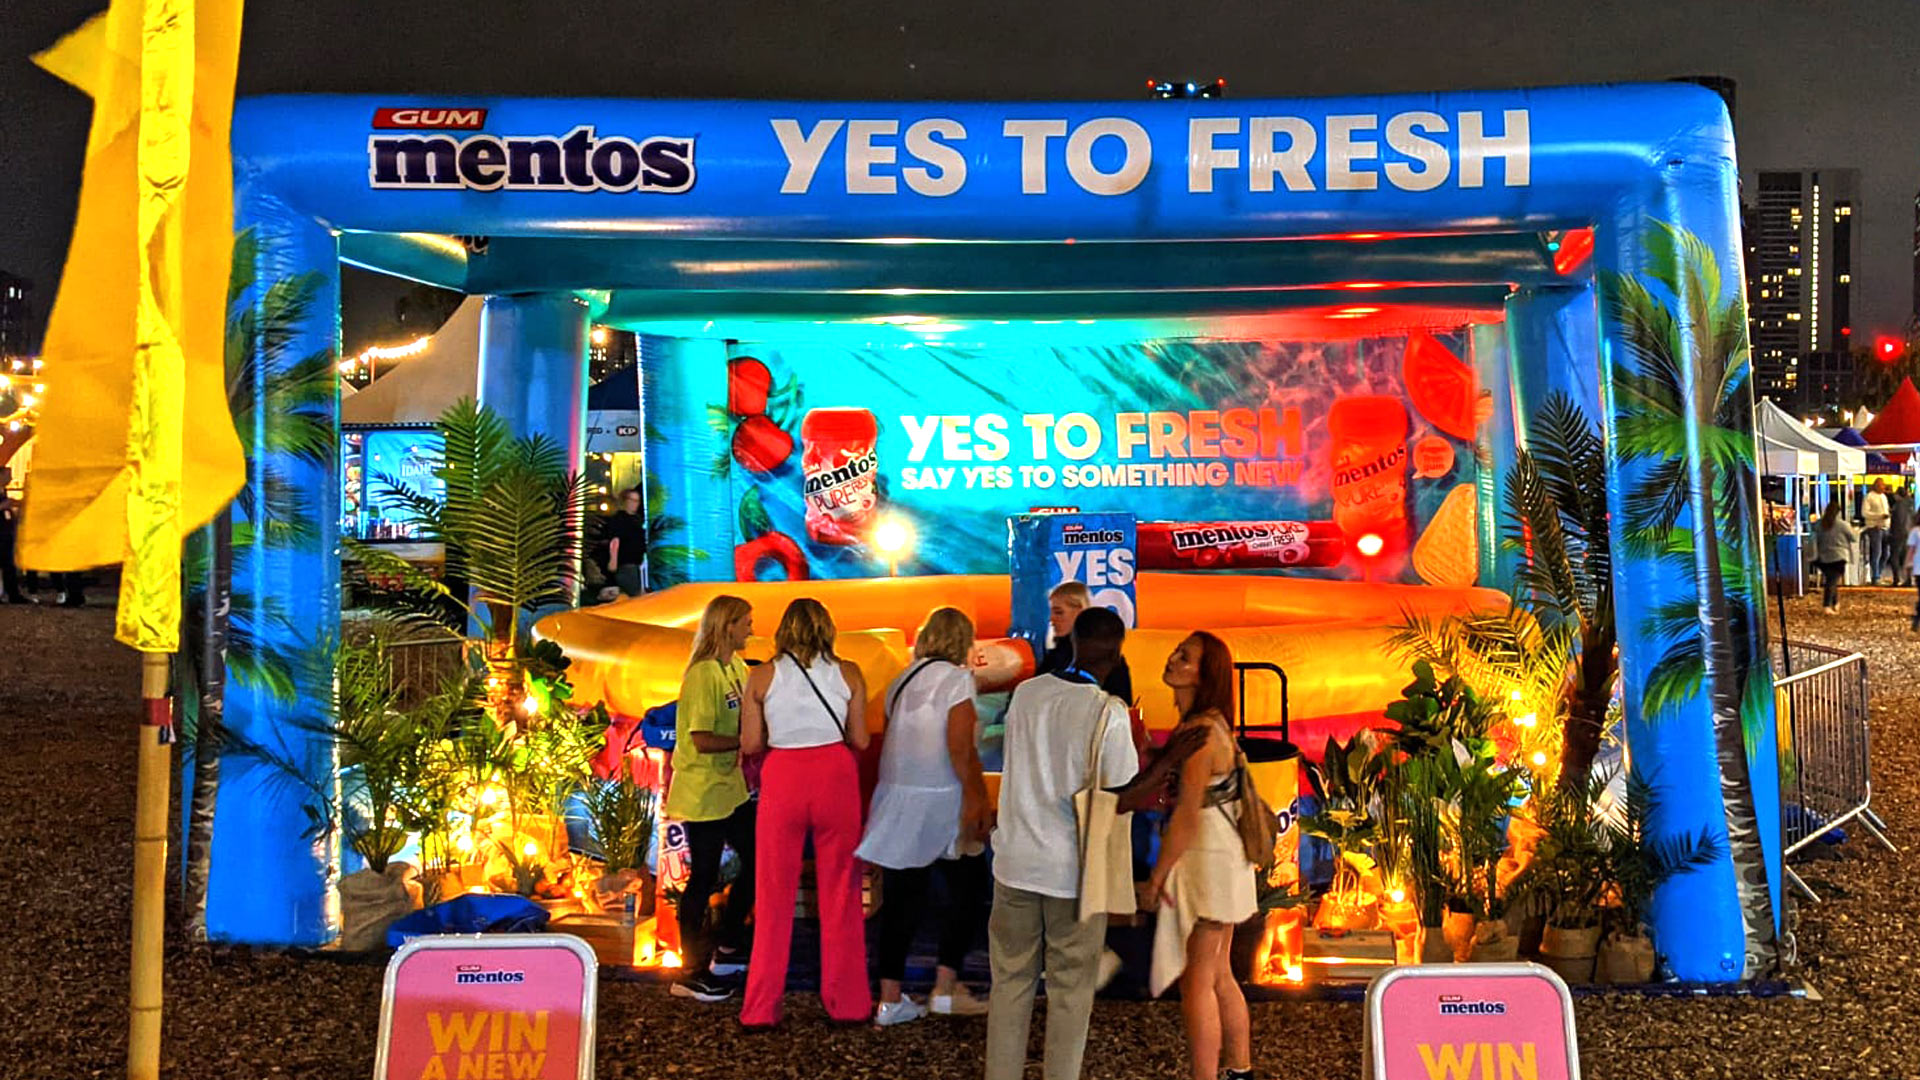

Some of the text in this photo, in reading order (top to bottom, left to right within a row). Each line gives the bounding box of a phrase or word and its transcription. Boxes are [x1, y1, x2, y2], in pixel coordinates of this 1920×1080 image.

[390, 109, 480, 126] GUM
[369, 126, 695, 193] mentos
[769, 109, 1531, 197] YES TO FRESH
[900, 406, 1302, 462] YES TO FRESH
[805, 447, 876, 494] mentos
[901, 461, 1303, 489] SAY YES TO SOMETHING NEW
[1334, 443, 1404, 488] mentos
[813, 482, 857, 512] PURE
[1063, 529, 1124, 545] mentos
[1174, 524, 1270, 549] mentos
[1054, 548, 1134, 586] YES
[660, 730, 677, 740] YE
[456, 969, 525, 984] mentos
[1440, 1001, 1507, 1015] mentos
[426, 1010, 549, 1053] WIN
[421, 1053, 547, 1080] A NEW
[1417, 1042, 1539, 1080] WIN
